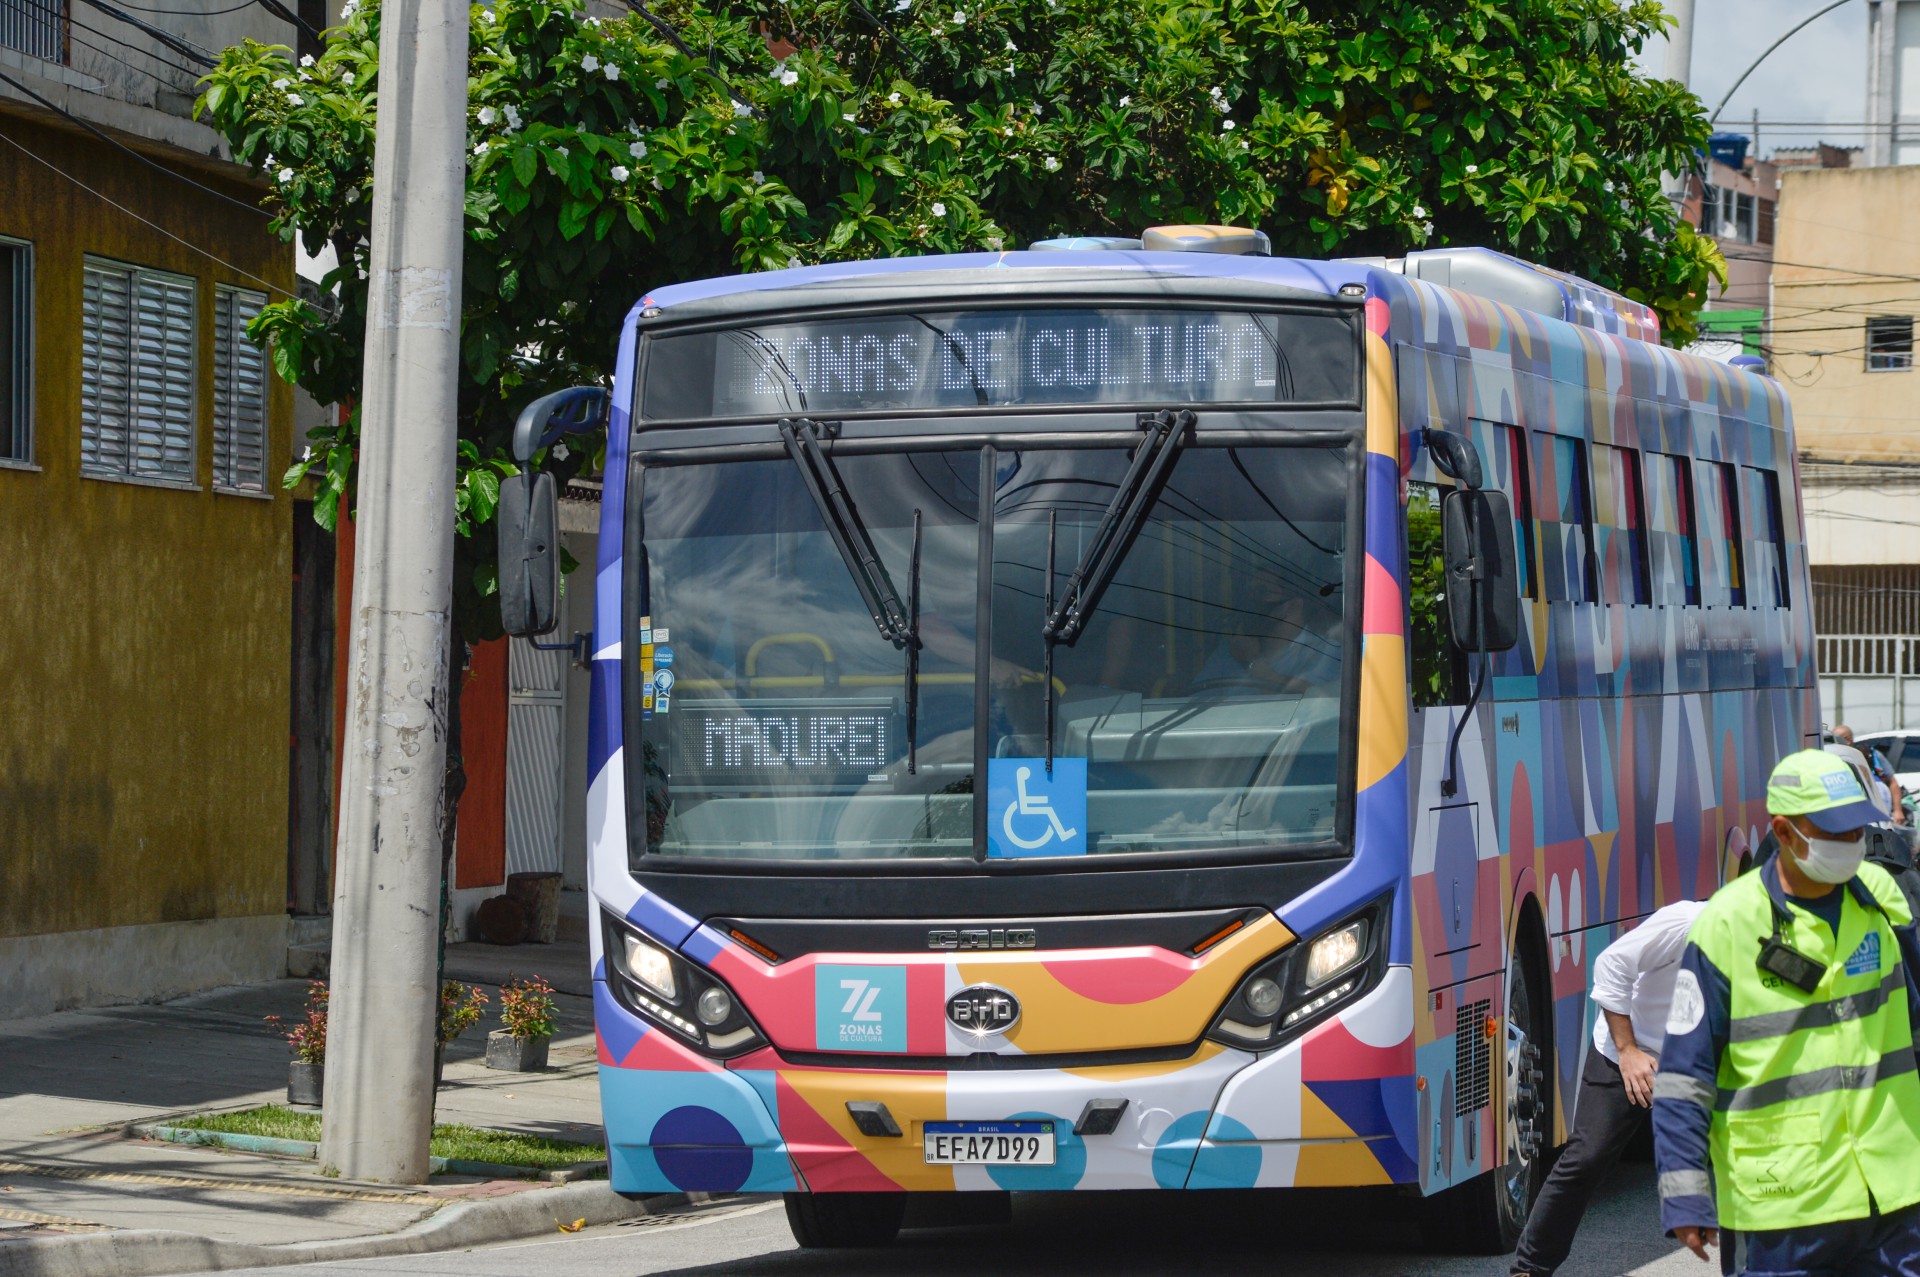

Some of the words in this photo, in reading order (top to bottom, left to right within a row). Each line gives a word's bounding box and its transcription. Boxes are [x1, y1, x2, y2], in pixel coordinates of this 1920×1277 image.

[754, 333, 918, 394] ZONAS
[943, 331, 1006, 389] DE
[1032, 323, 1262, 386] CULTURA
[705, 716, 885, 766] MADUREI
[954, 999, 1012, 1021] BYD
[839, 1024, 882, 1036] ZONAS
[926, 1153, 935, 1161] BR
[936, 1136, 1040, 1160] EFA7D99
[1758, 1186, 1795, 1196] SIGMA
